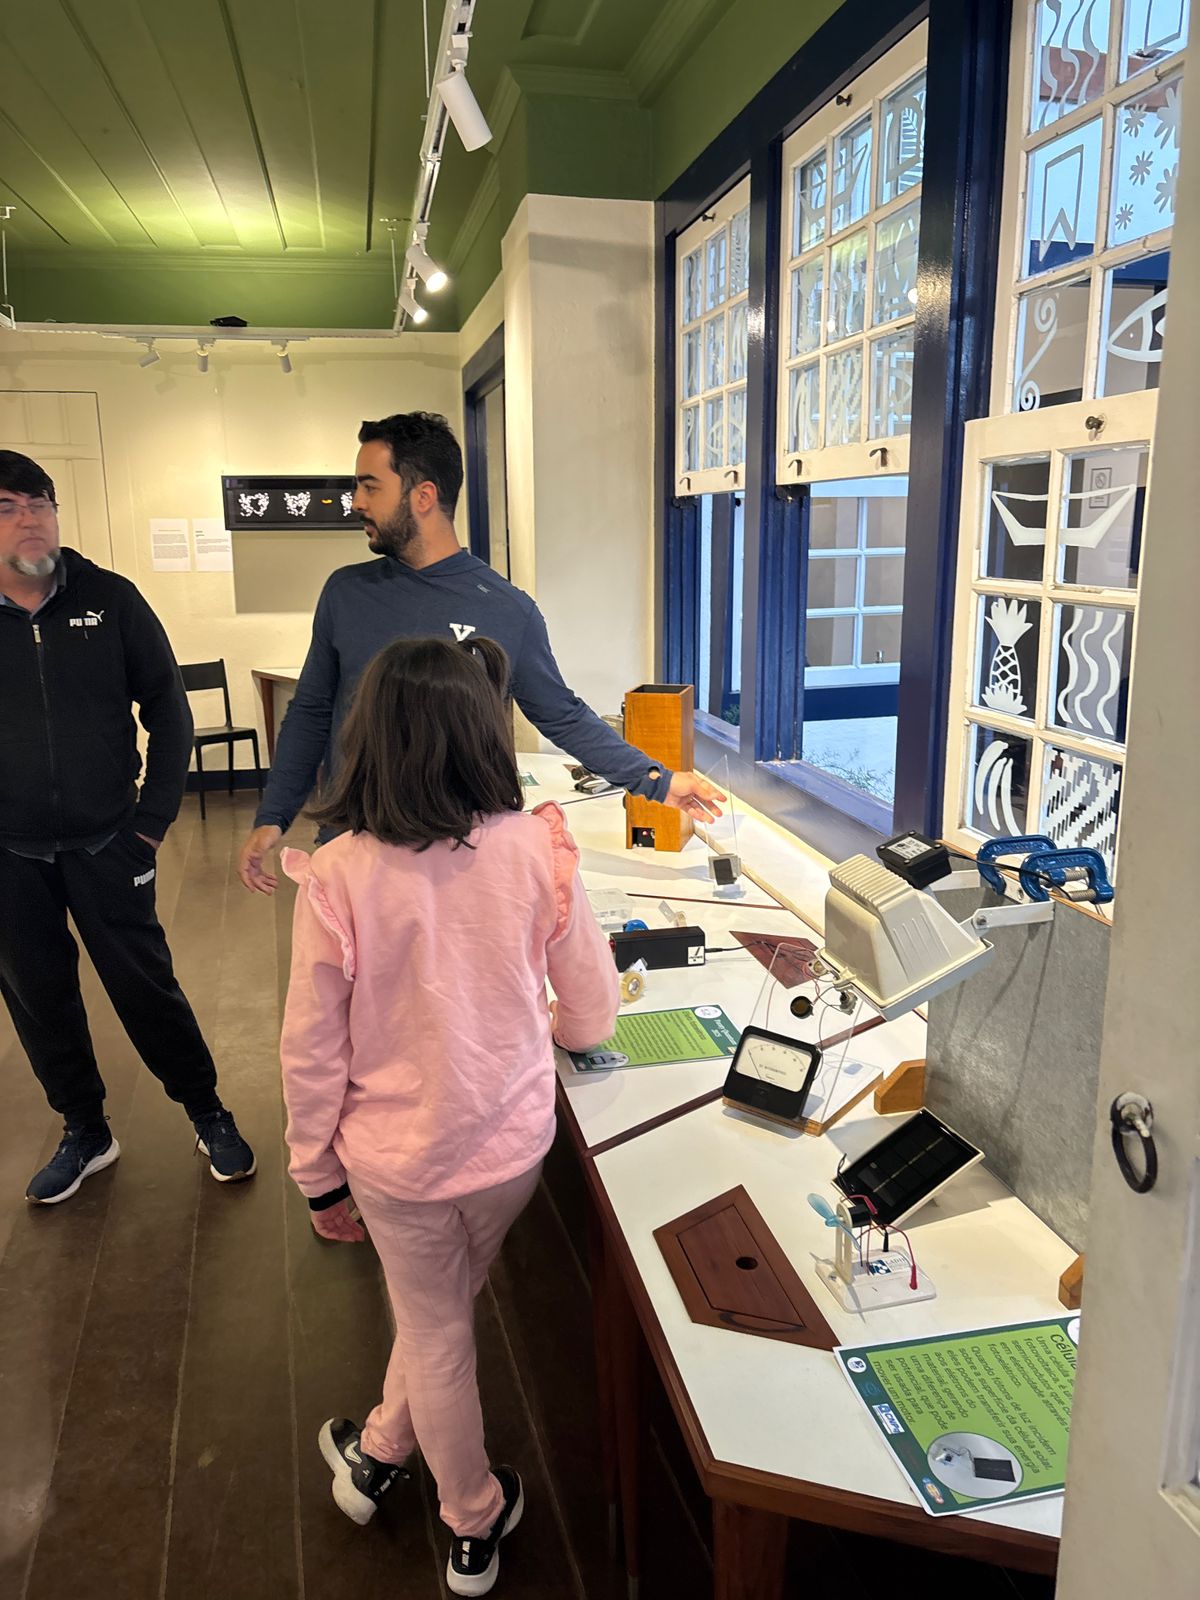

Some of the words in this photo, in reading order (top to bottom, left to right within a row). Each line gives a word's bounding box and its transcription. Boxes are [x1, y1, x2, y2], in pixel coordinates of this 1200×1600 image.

[873, 1361, 892, 1384] mover
[887, 1386, 900, 1399] um
[933, 1351, 948, 1366] aos
[965, 1398, 976, 1408] do
[999, 1341, 1012, 1354] em
[1008, 1355, 1045, 1398] eletricidade
[1011, 1339, 1054, 1390] semicondutor
[1049, 1391, 1065, 1405] que
[1035, 1335, 1052, 1355] Uma
[1048, 1355, 1070, 1377] célula
[885, 1358, 897, 1371] ser
[892, 1372, 912, 1397] usada
[905, 1397, 924, 1414] para
[909, 1354, 925, 1373] uma
[944, 1409, 956, 1420] de
[919, 1394, 935, 1409] que
[928, 1410, 948, 1430] pode
[941, 1387, 968, 1418] gerando
[946, 1349, 961, 1366] eles
[954, 1366, 979, 1393] podem
[975, 1393, 1006, 1428] transferir
[1001, 1429, 1017, 1444] sua
[1013, 1444, 1040, 1473] energia
[957, 1347, 977, 1370] sobre
[1005, 1414, 1017, 1424] da
[1013, 1425, 1036, 1449] célula
[970, 1345, 995, 1376] Quando
[1009, 1401, 1022, 1411] de
[1018, 1411, 1032, 1423] luz
[1027, 1424, 1056, 1455] incidem
